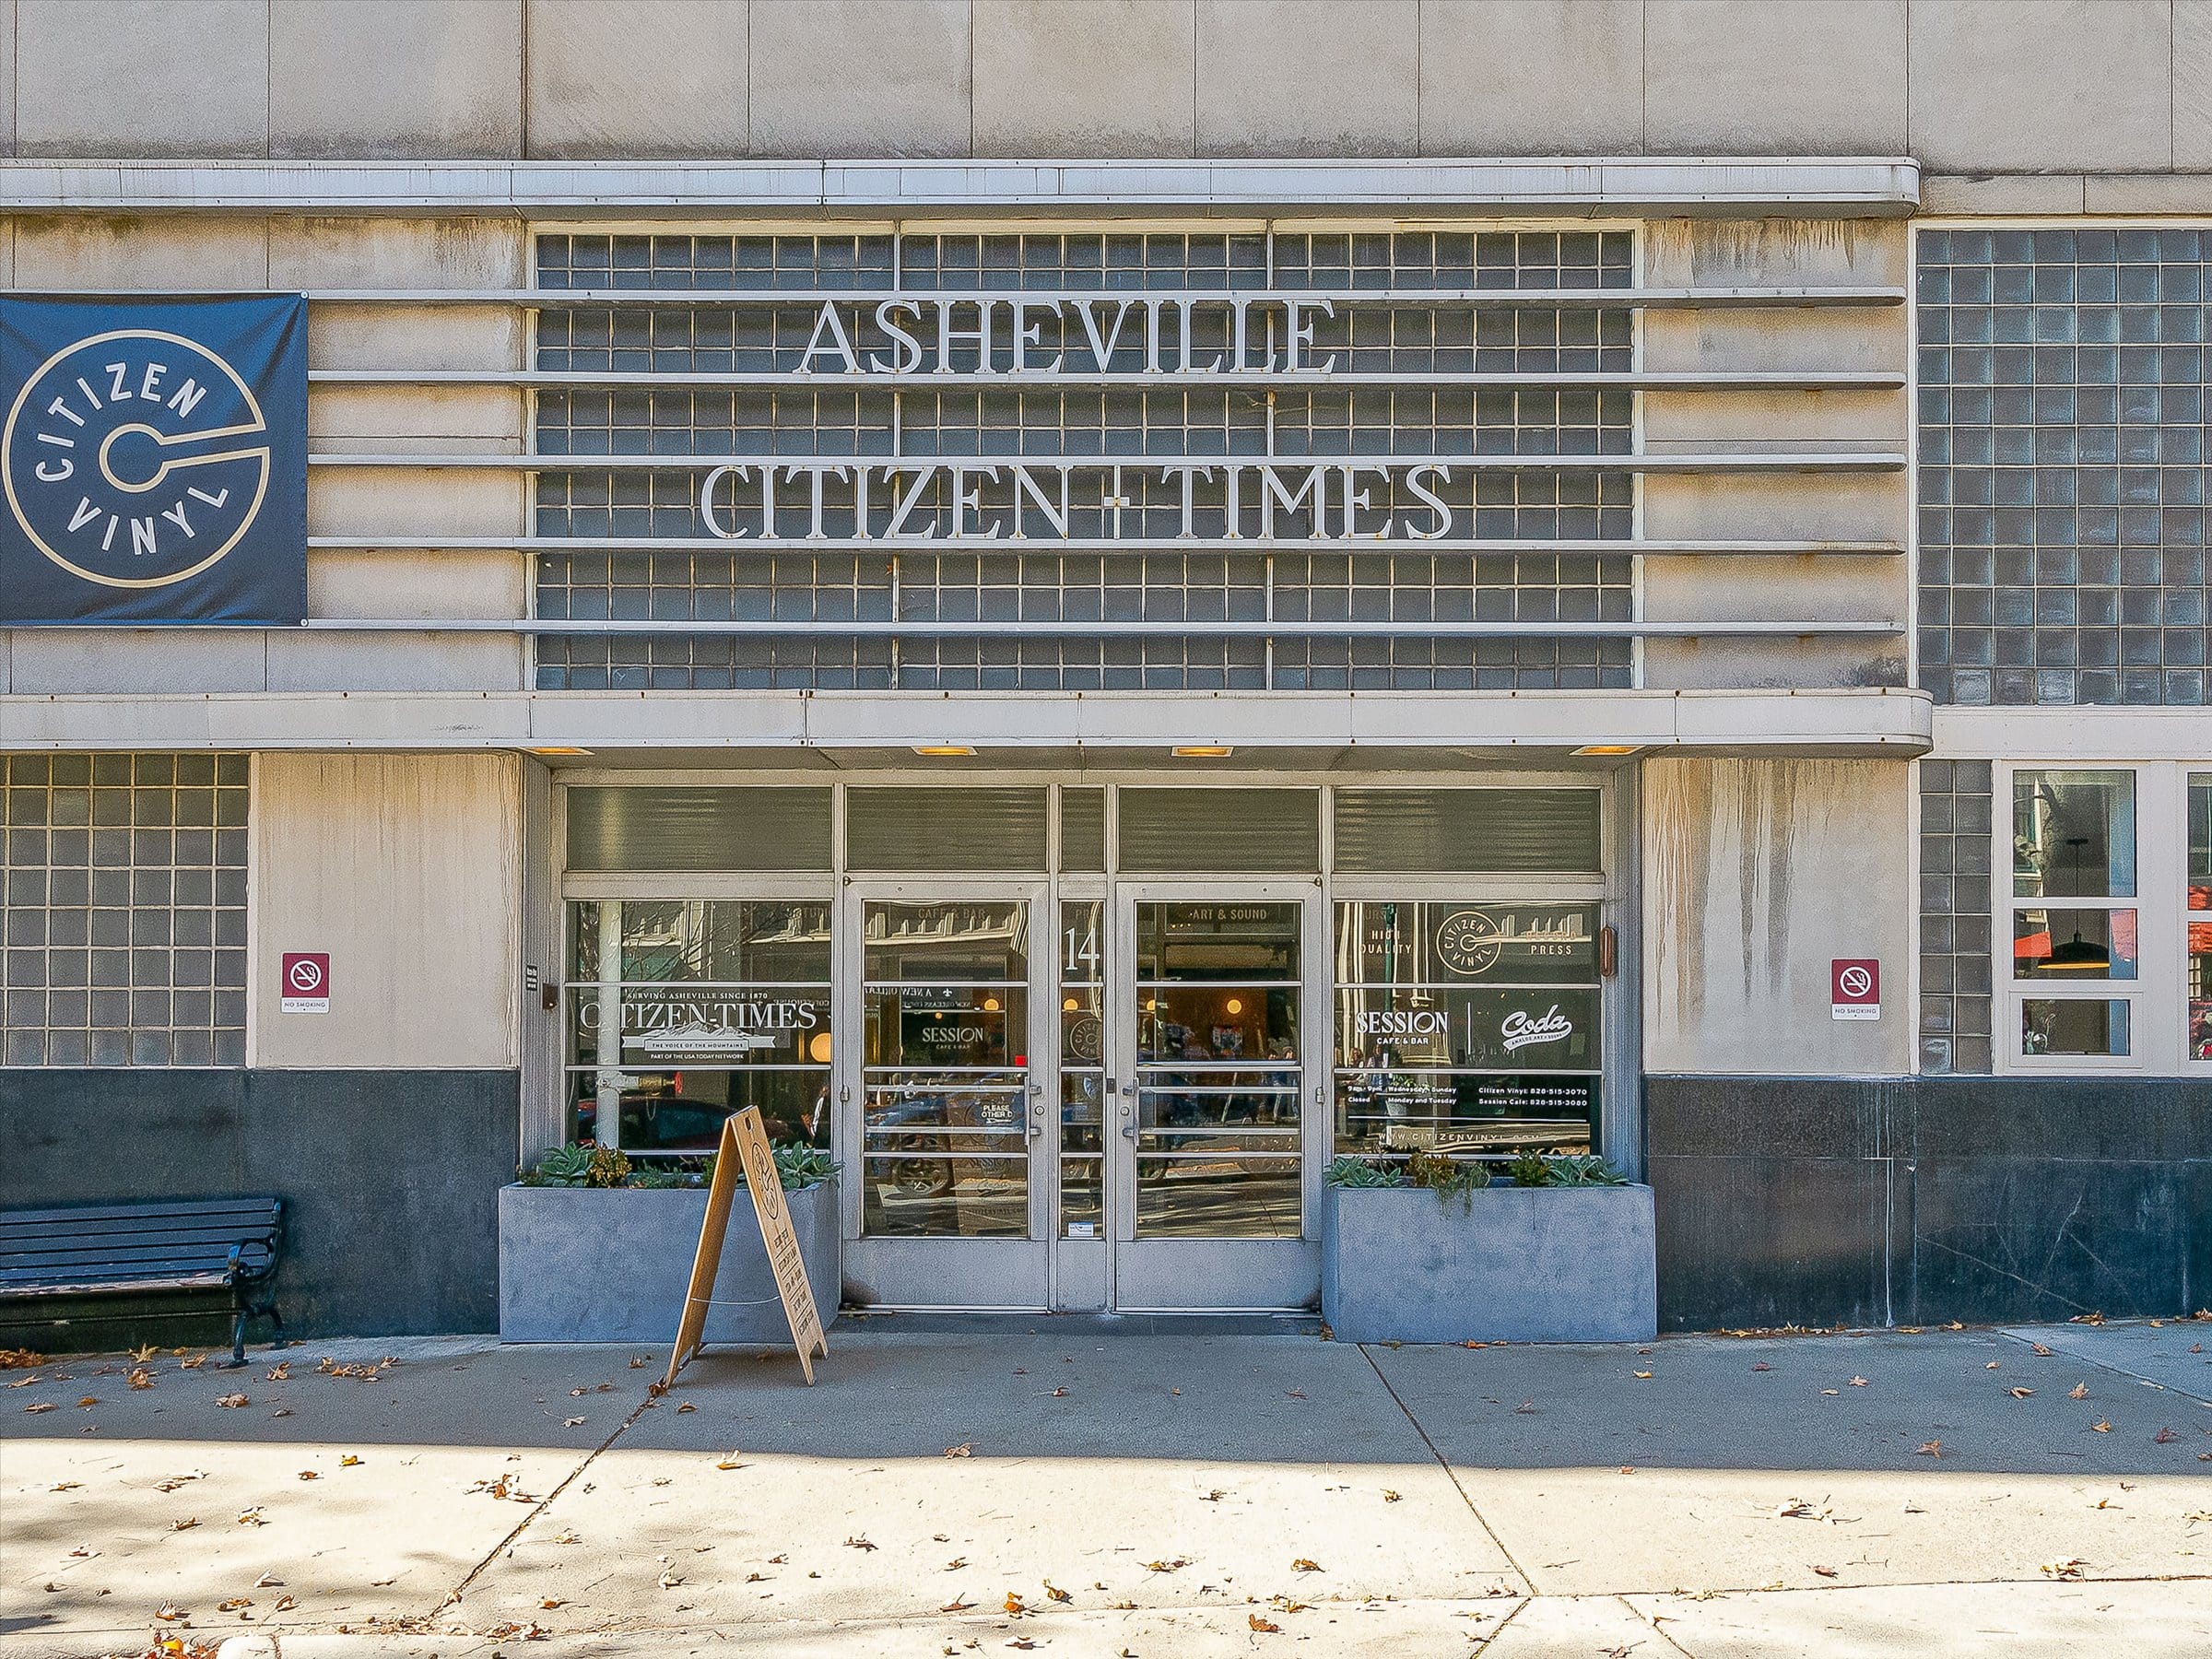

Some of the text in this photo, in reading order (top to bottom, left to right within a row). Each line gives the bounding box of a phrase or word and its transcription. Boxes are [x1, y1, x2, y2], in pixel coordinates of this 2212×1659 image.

[792, 299, 1336, 375] ASHEVILLE
[35, 361, 207, 482] CITIZEN
[700, 464, 1078, 540] CITIZEN
[1160, 464, 1453, 540] TIMES
[66, 487, 229, 555] VINYL
[1193, 909, 1267, 920] ART & SOUND
[1444, 919, 1487, 949] CITIZEN
[1064, 927, 1100, 971] 14
[1452, 948, 1492, 967] VINYL
[1530, 945, 1572, 955] PRESS
[580, 1002, 817, 1030] CTIZEN-TIMES
[1357, 1011, 1449, 1033] SESSION
[1501, 1004, 1572, 1038] Coda
[922, 1027, 983, 1042] SESSION
[1377, 1037, 1429, 1045] CAFE & BAR
[1429, 1097, 1457, 1105] Tuesday
